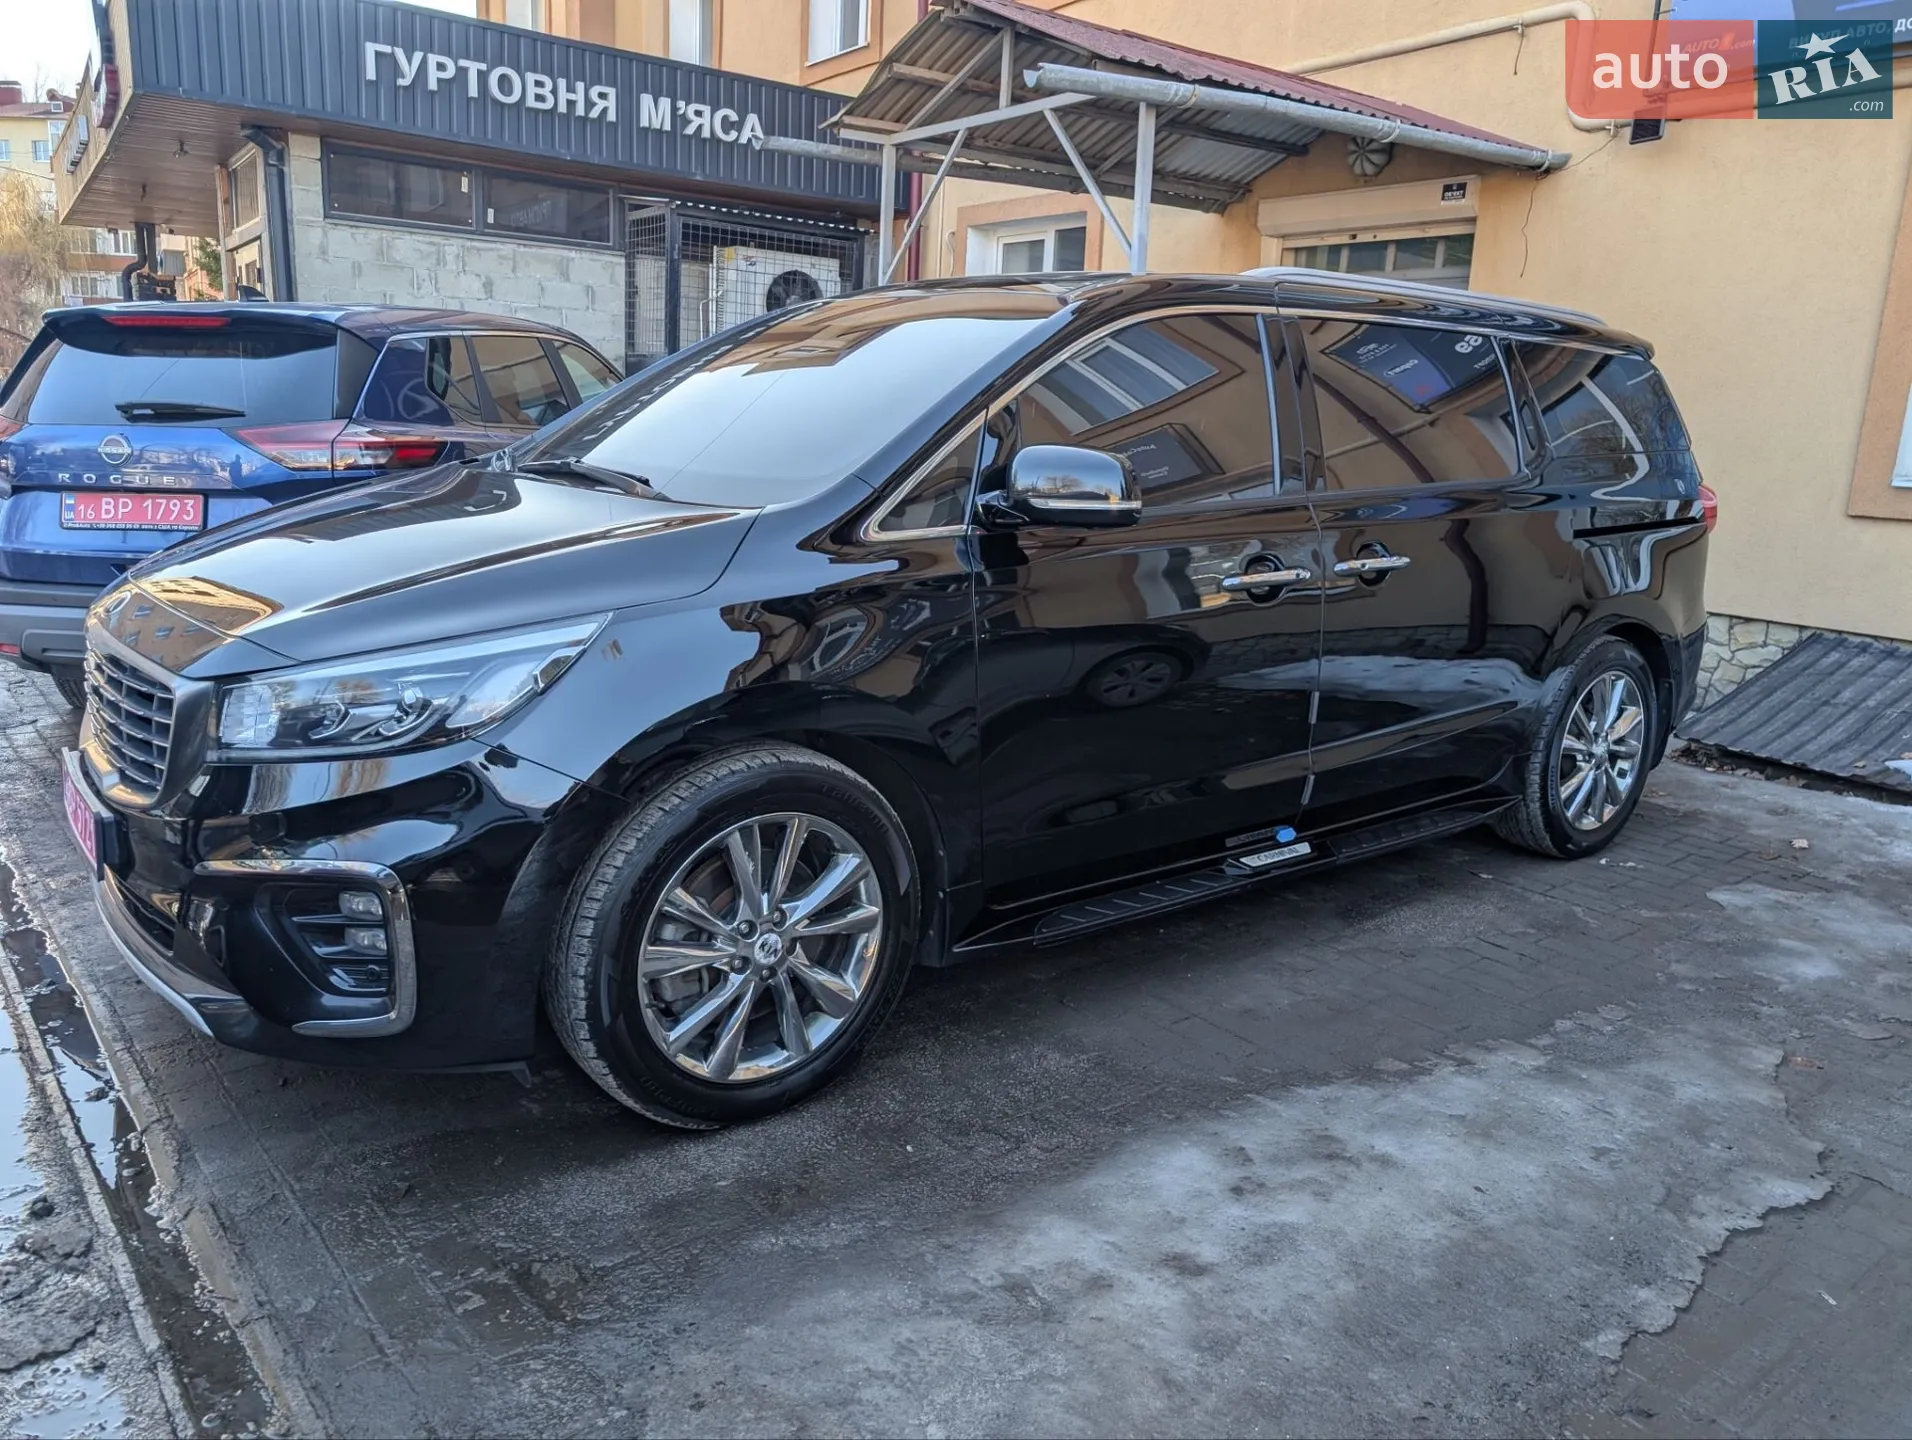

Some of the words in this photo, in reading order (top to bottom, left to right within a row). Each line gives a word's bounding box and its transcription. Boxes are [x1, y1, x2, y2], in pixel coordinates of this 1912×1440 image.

[364, 41, 617, 123] ГУРТОВНЯ
[97, 446, 132, 455] NISSAN
[57, 472, 177, 486] ROGUE
[64, 510, 75, 519] UA
[78, 504, 96, 520] 16
[101, 497, 133, 520] BP
[142, 499, 195, 521] 1793
[758, 940, 779, 960] KIA
